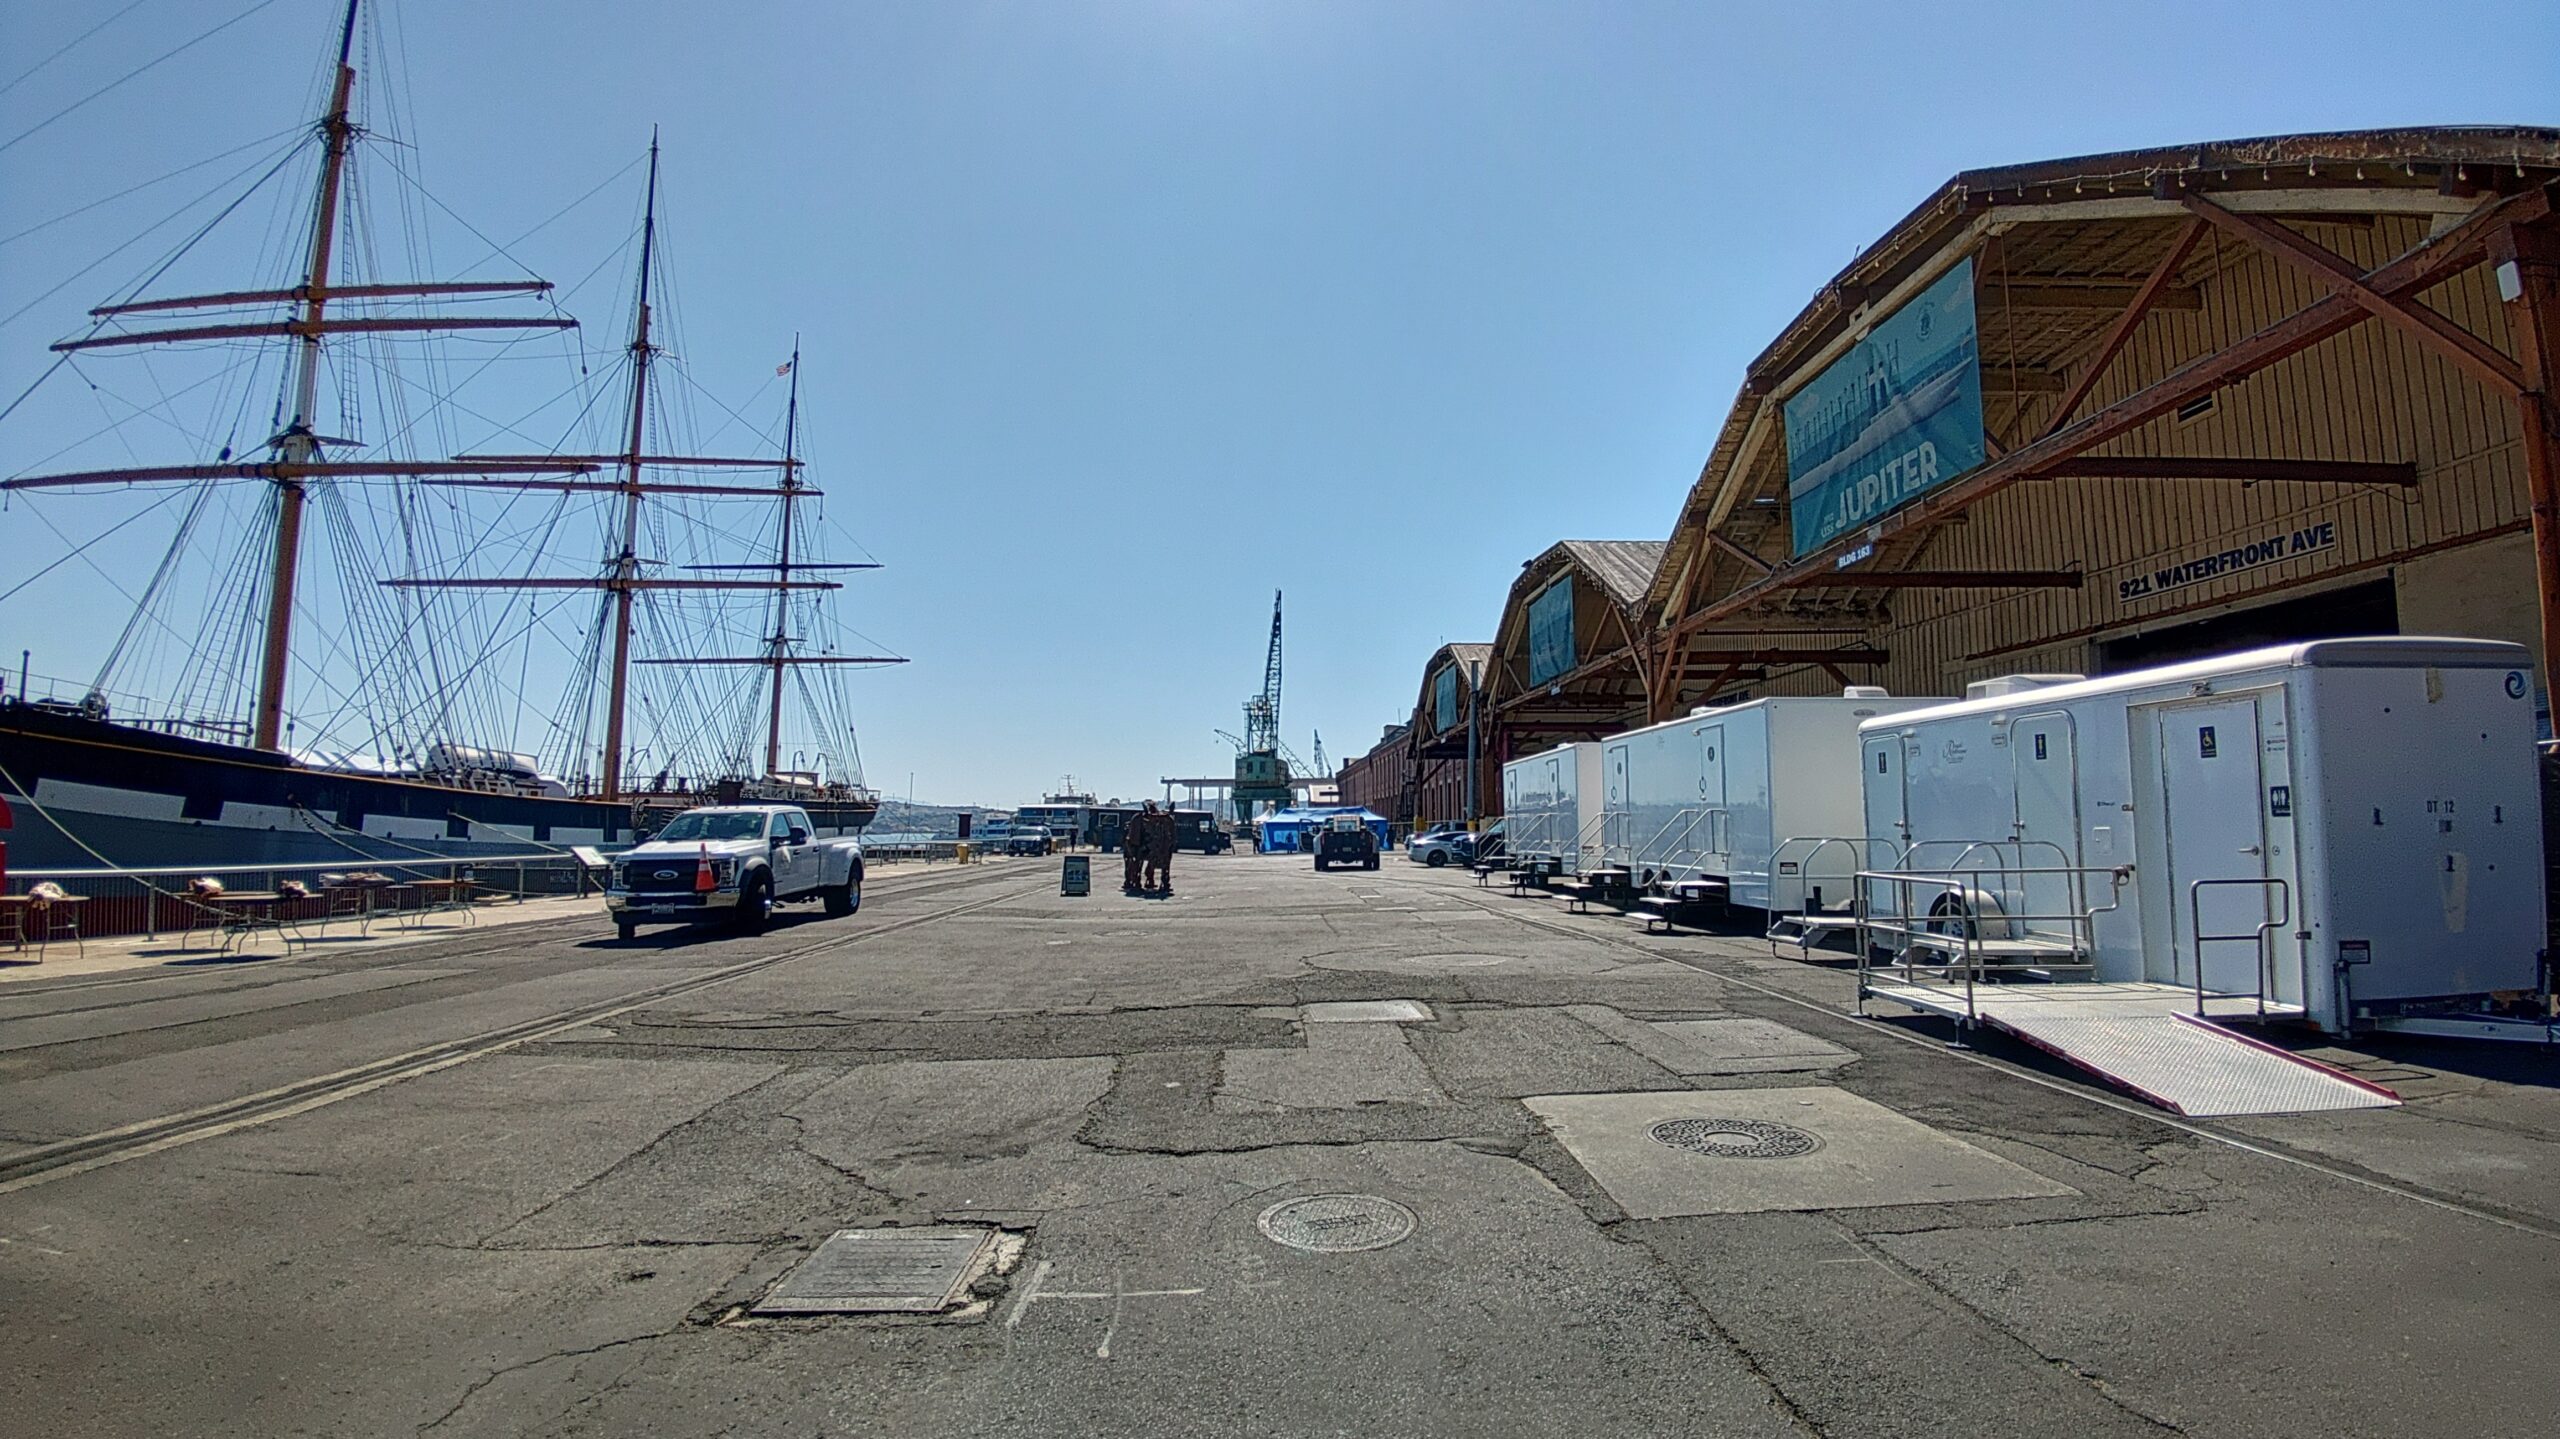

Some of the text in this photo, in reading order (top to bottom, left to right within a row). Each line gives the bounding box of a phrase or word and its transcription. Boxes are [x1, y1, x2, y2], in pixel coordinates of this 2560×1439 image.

[1835, 441, 1937, 528] JUPITER
[1838, 545, 1870, 568] BLDG 163
[2119, 522, 2335, 598] 921 WATERFRONT AVE
[2444, 800, 2455, 813] 12
